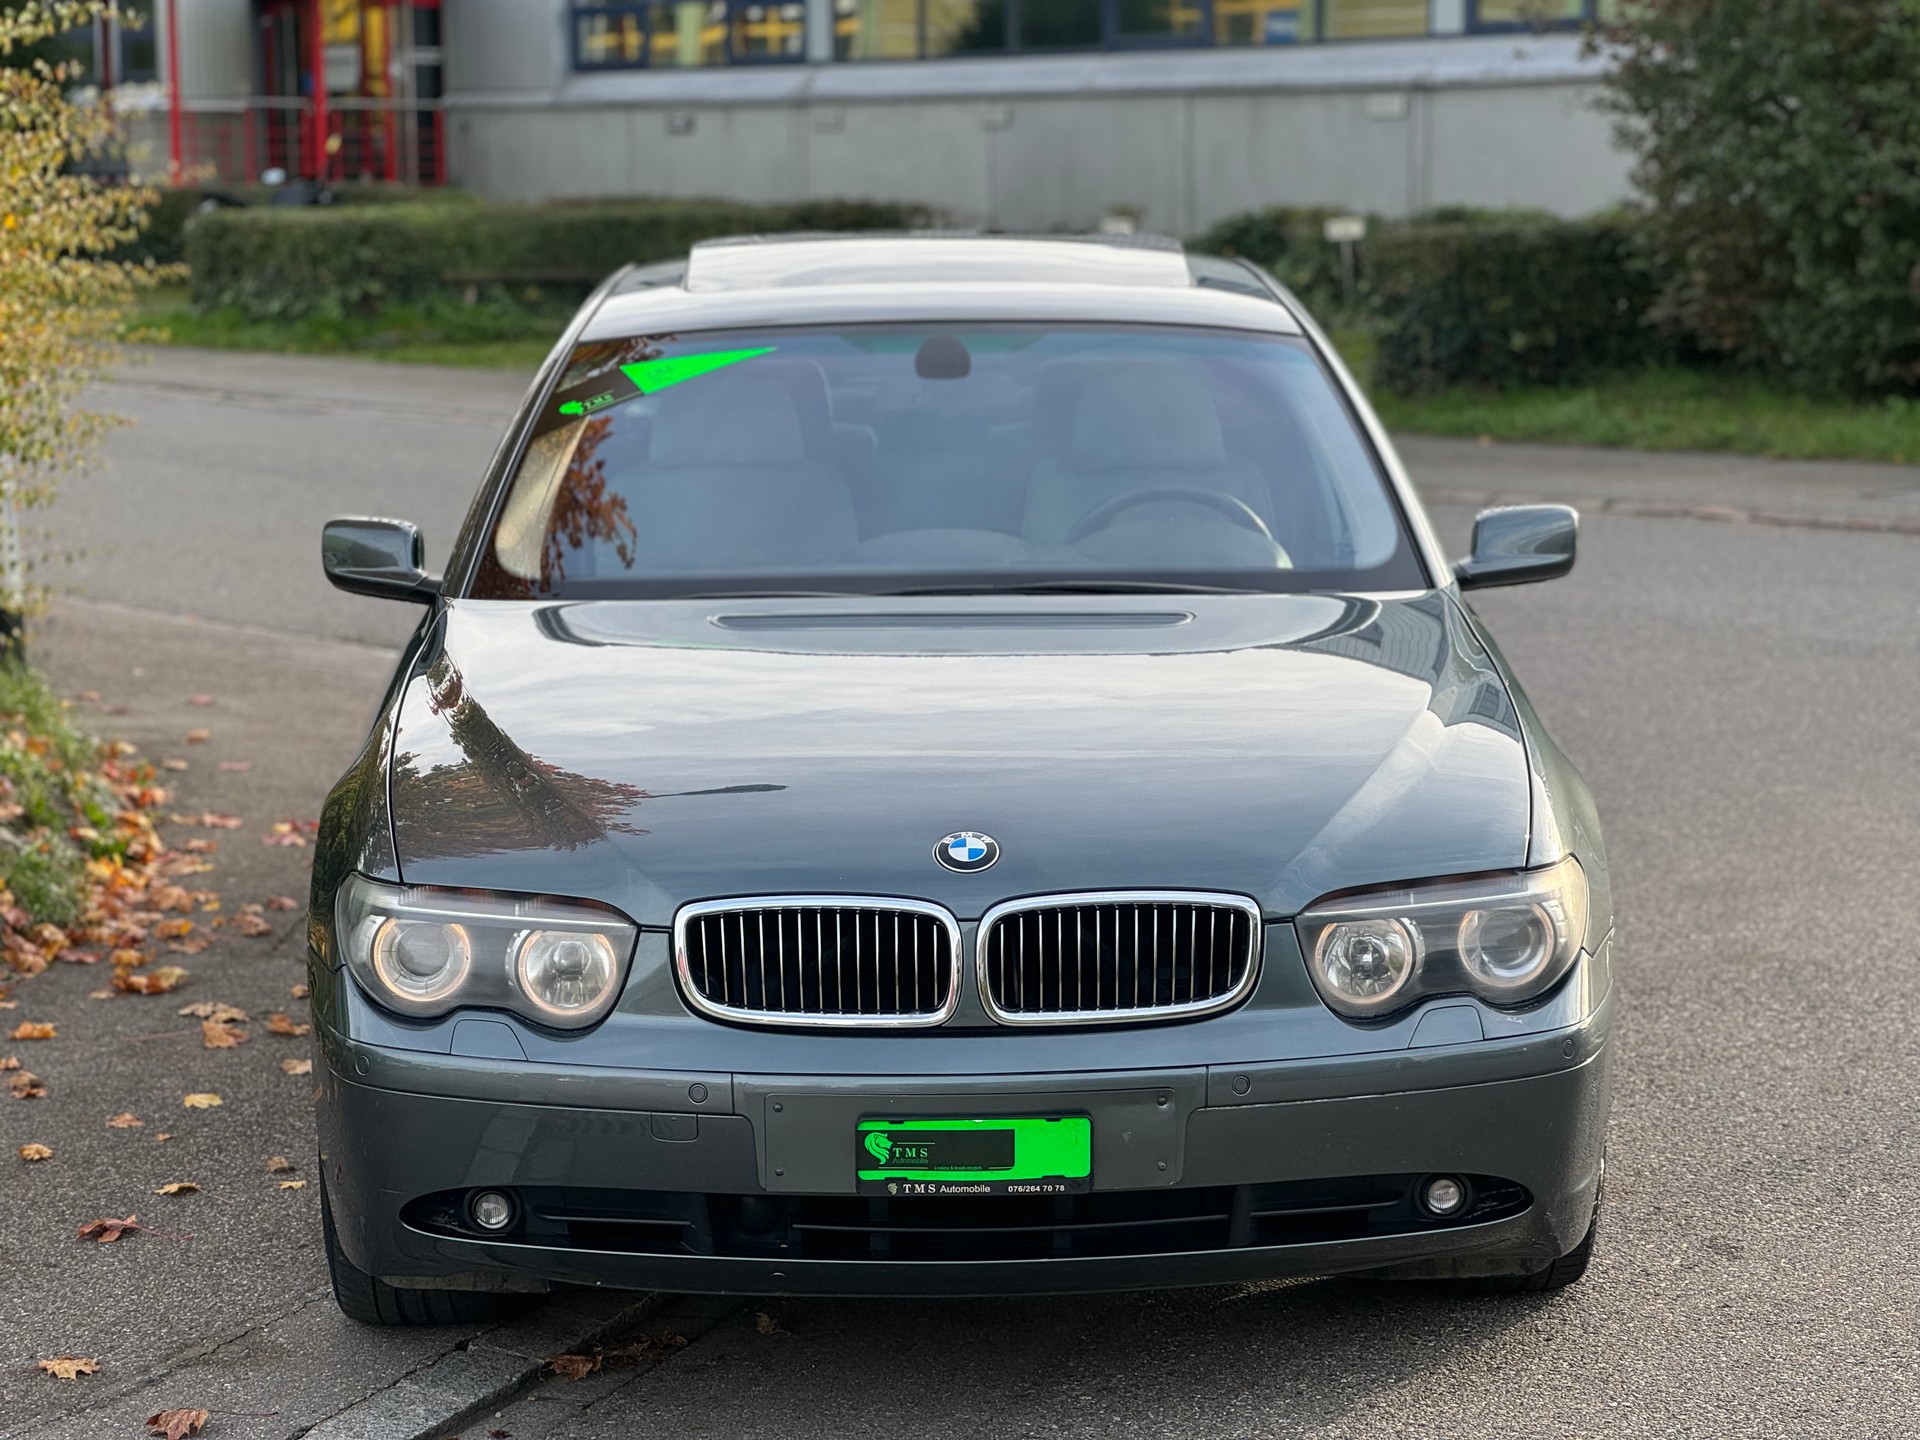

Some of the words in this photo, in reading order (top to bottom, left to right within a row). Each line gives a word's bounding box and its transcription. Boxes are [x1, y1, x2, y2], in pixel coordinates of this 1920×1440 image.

[942, 832, 994, 844] BMW
[940, 1185, 990, 1193] Automobile
[1008, 1185, 1040, 1193] 076/264
